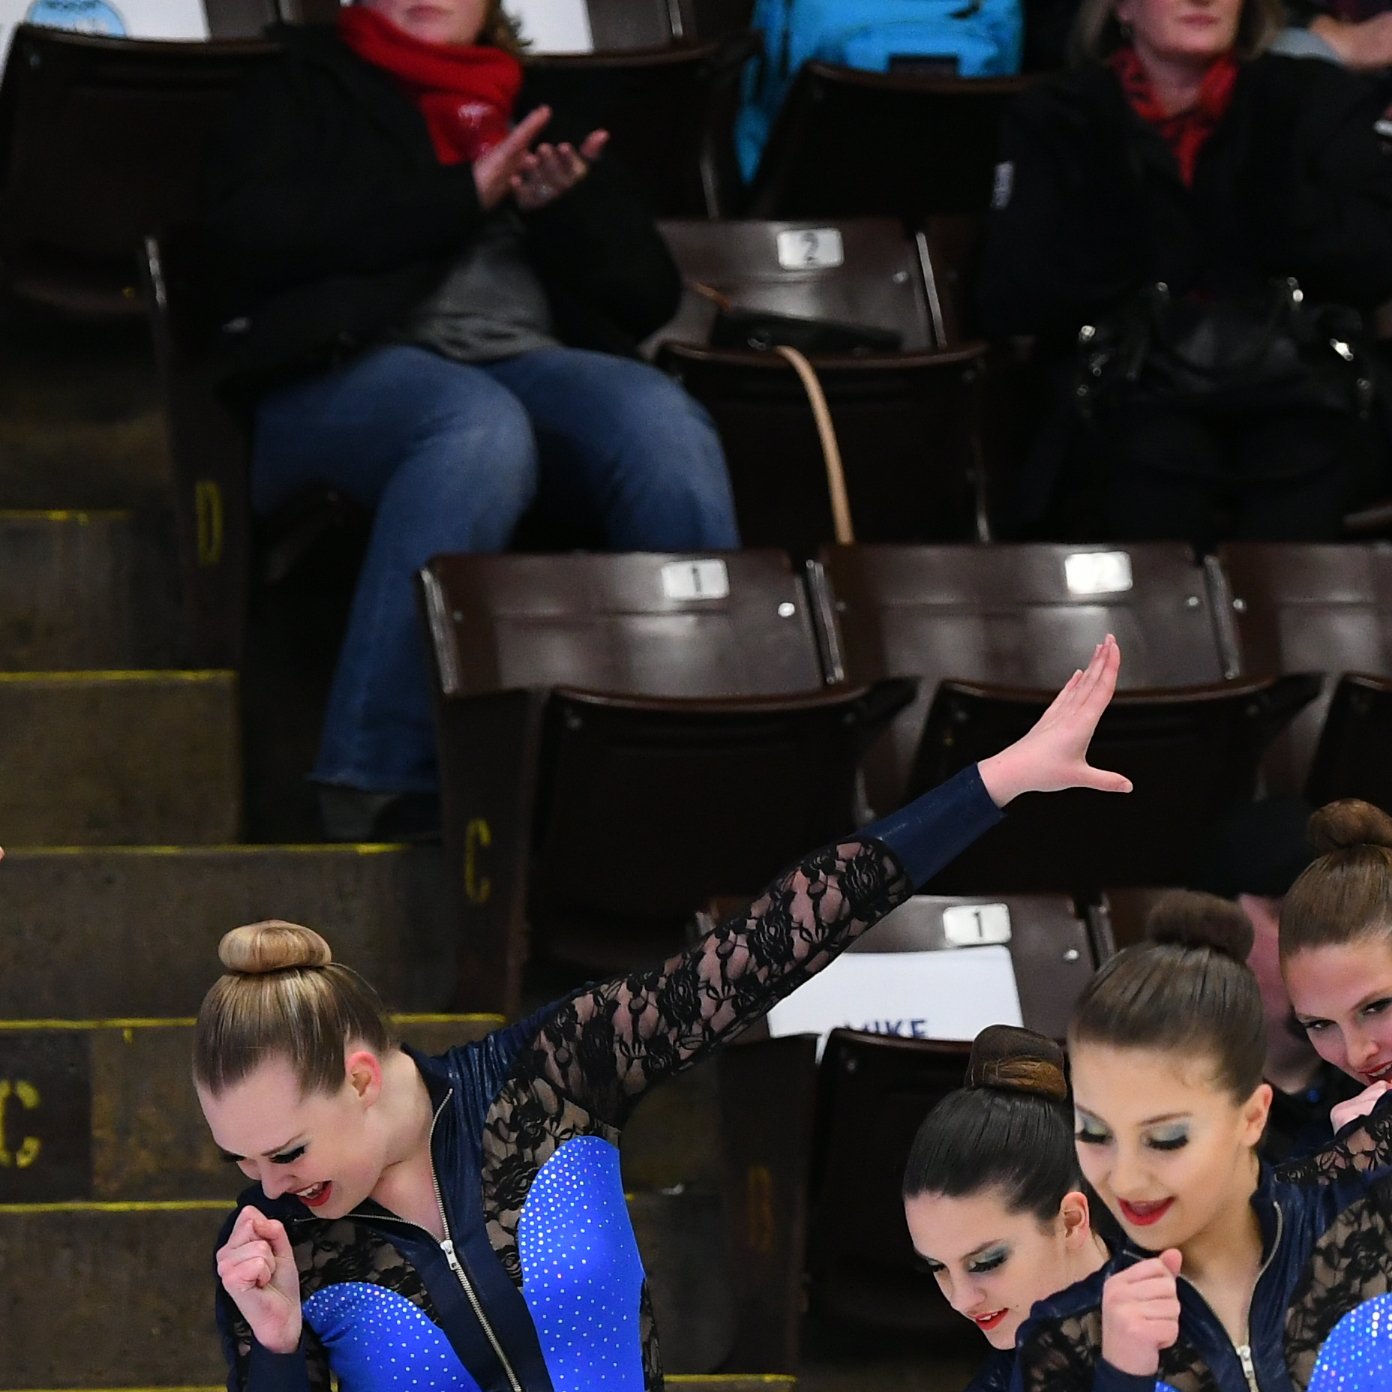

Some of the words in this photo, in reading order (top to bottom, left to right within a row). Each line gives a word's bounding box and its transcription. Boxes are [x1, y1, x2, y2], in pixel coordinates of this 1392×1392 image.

[800, 231, 820, 262] 2
[194, 481, 224, 566] D
[463, 817, 492, 904] C
[971, 911, 984, 938] 1
